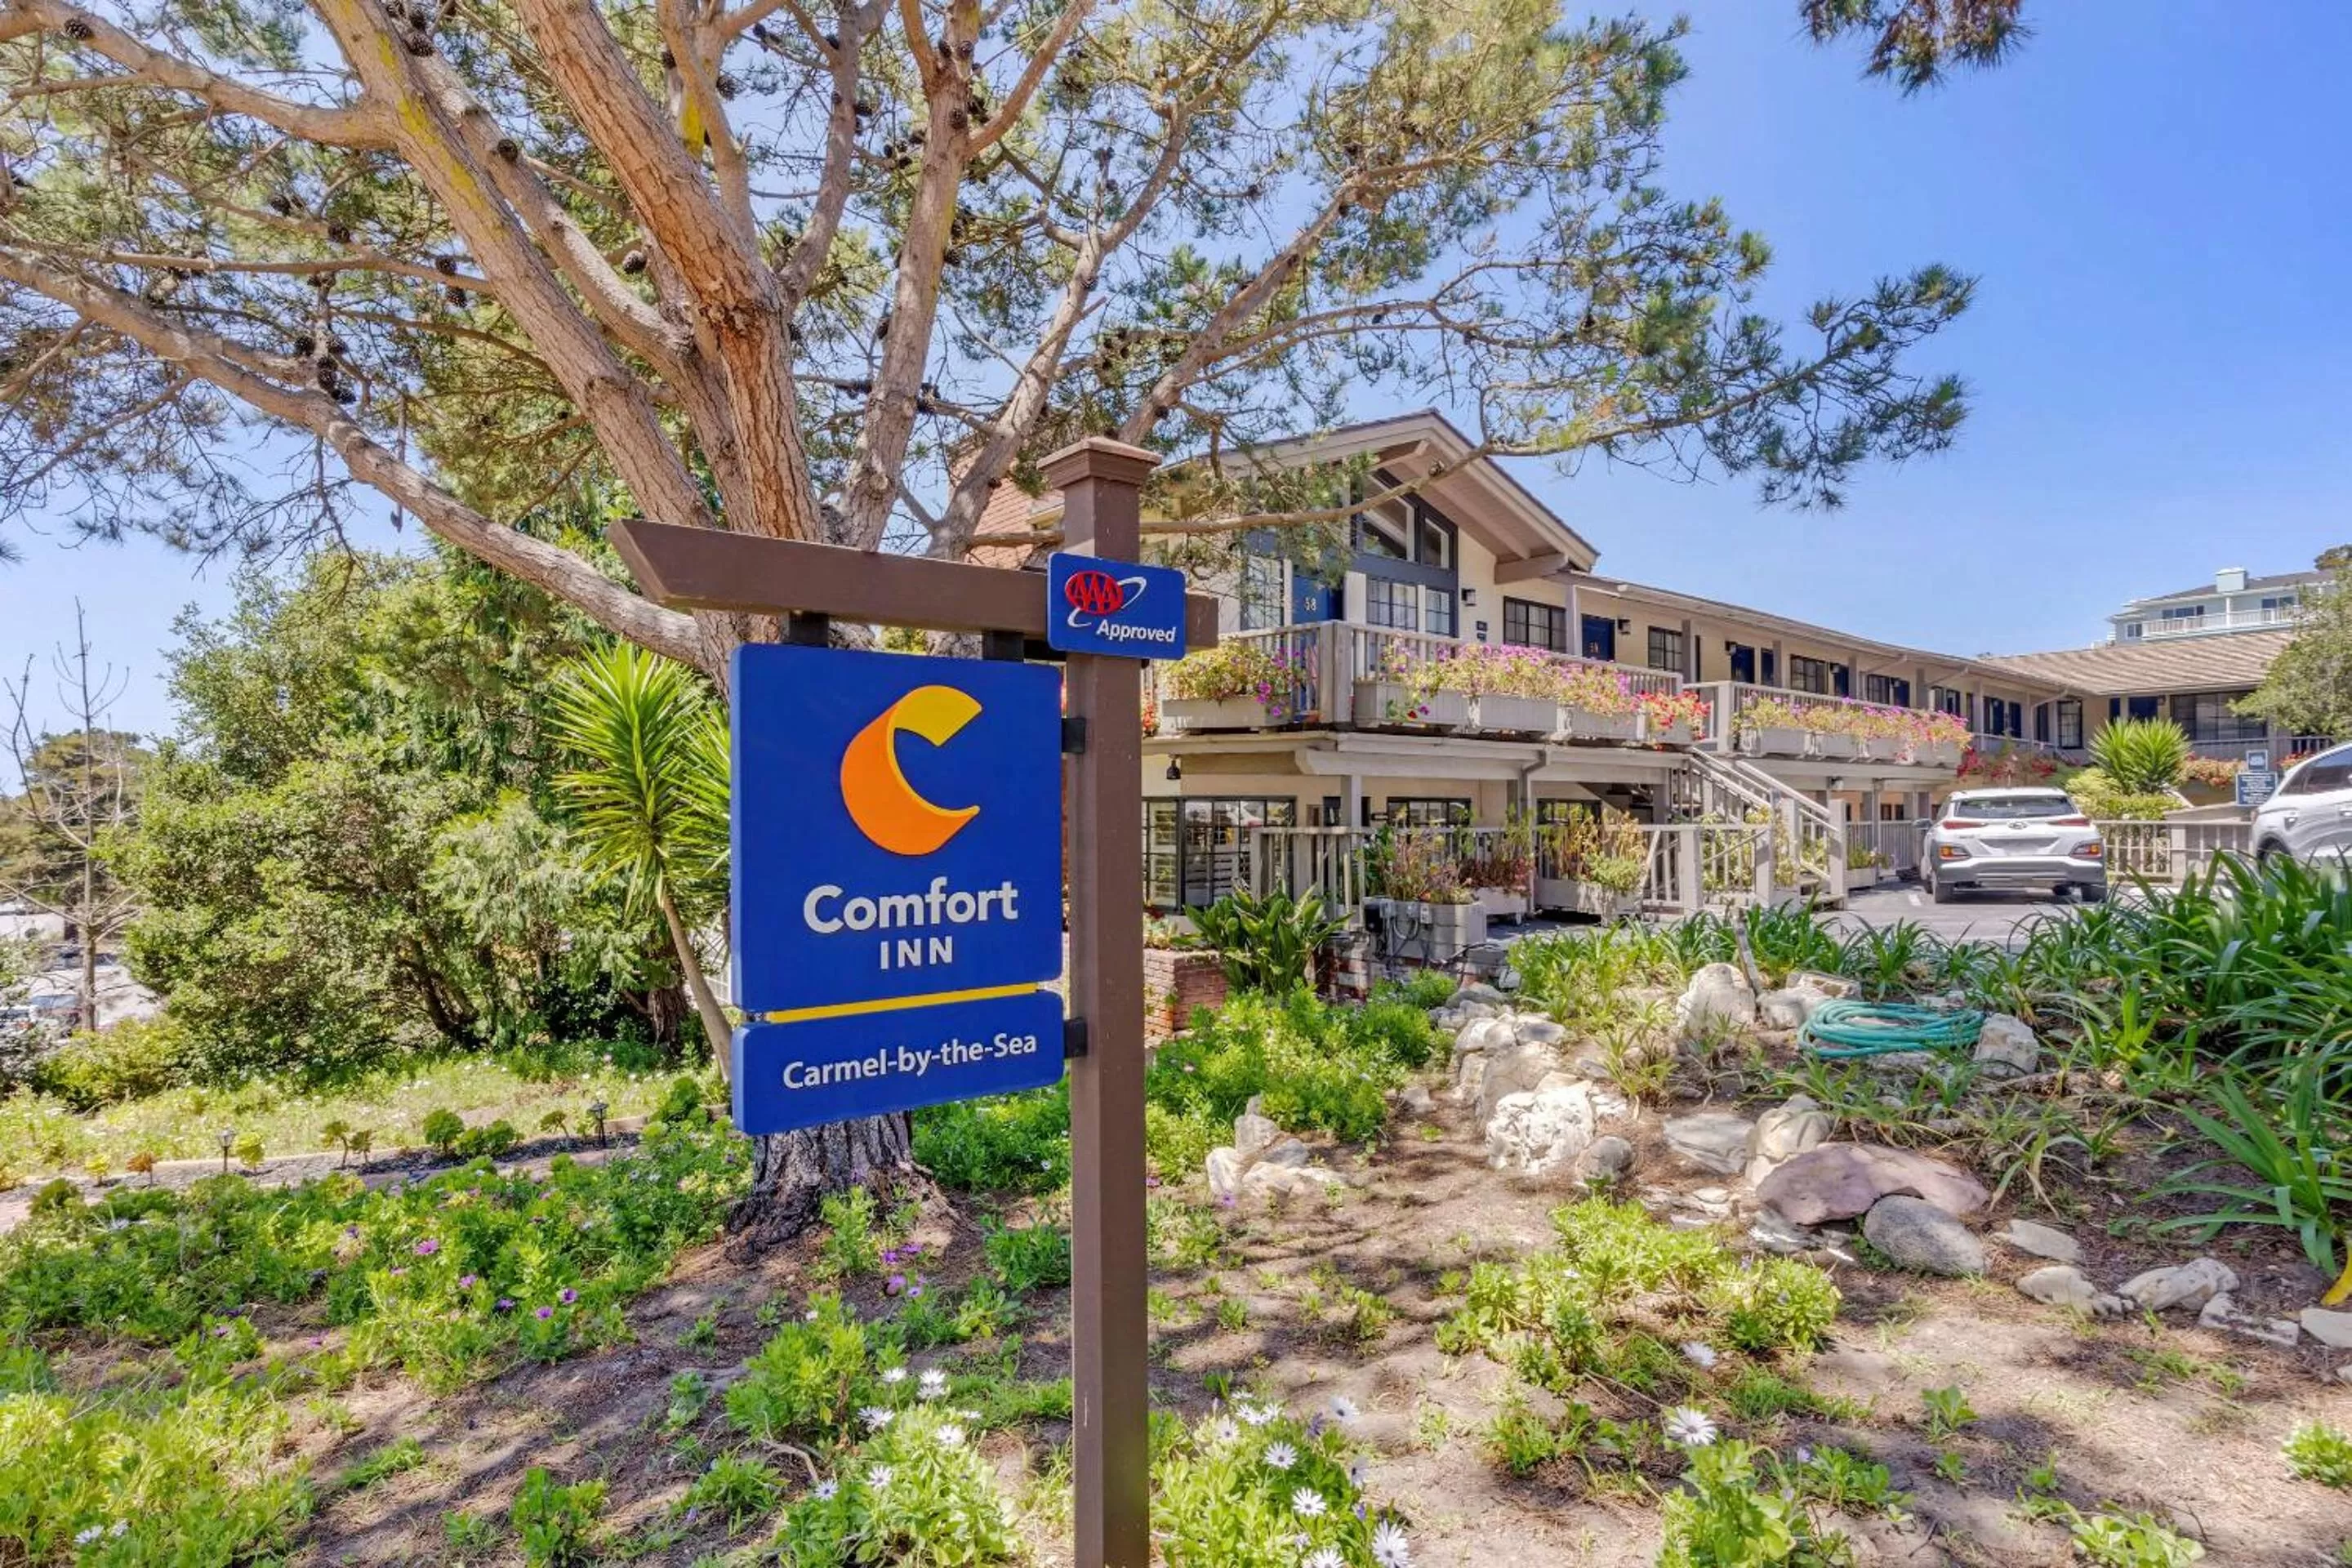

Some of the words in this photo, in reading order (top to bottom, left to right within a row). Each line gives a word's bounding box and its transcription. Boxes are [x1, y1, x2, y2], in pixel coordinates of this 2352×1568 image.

[1071, 572, 1120, 613] AAA
[1095, 619, 1177, 643] Approved
[804, 877, 1018, 933] Comfort
[881, 937, 952, 969] INN
[782, 1033, 1037, 1089] Carmel-by-the-Sea
